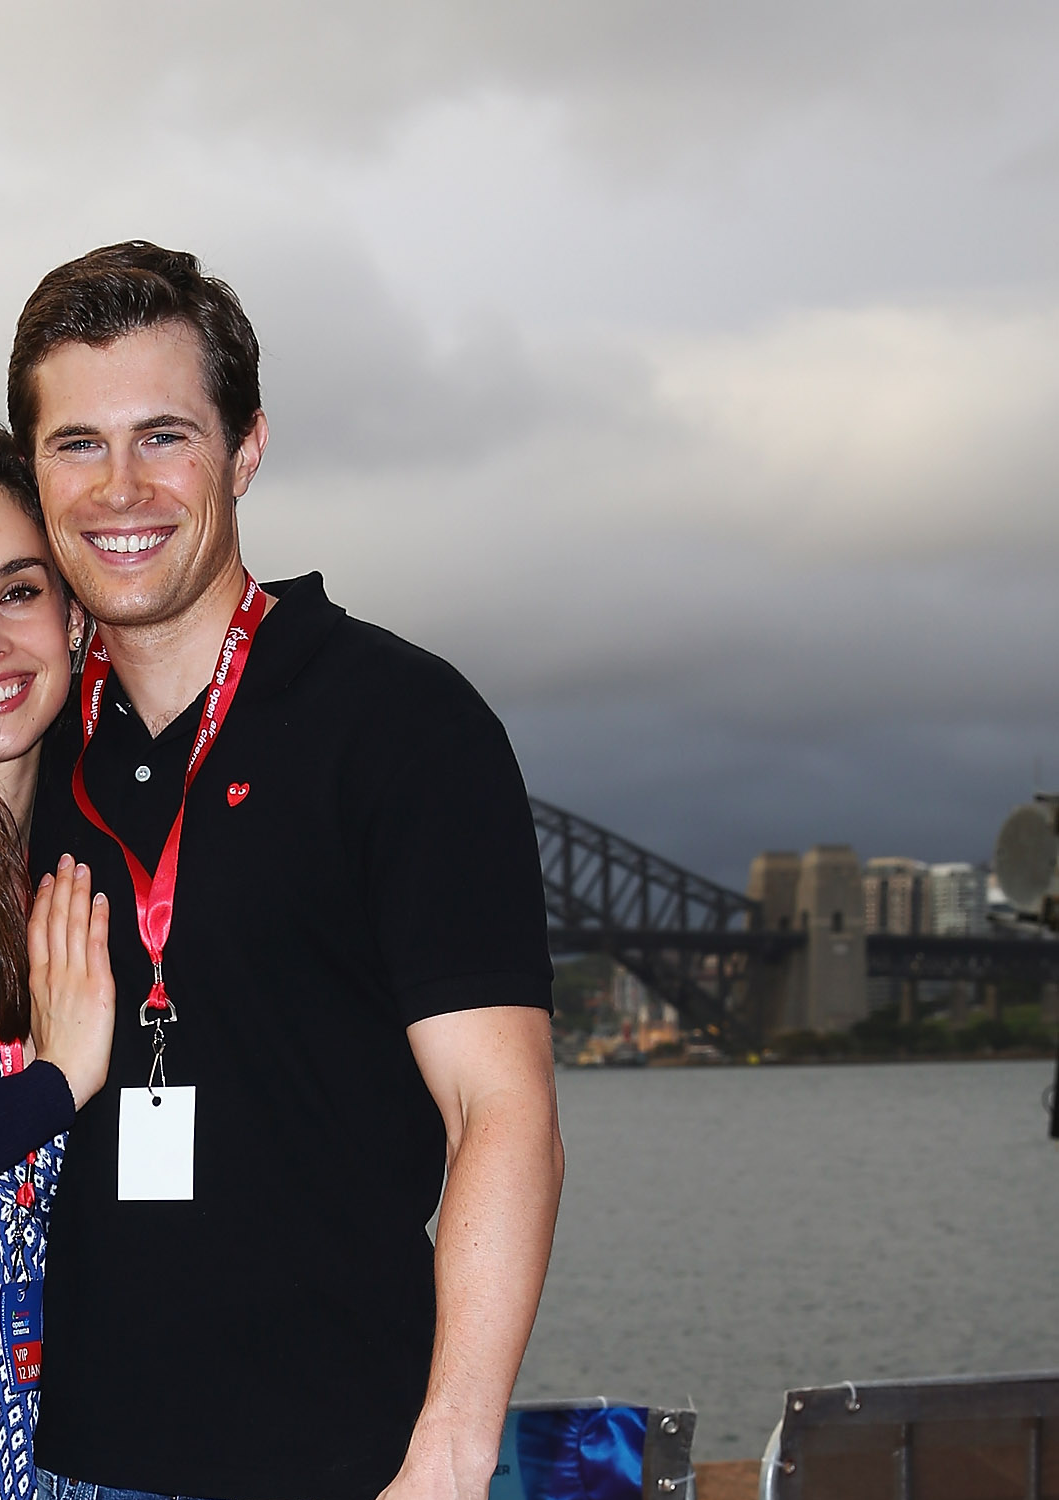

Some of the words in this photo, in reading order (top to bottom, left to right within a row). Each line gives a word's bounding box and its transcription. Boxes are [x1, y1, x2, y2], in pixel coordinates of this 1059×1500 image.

[241, 581, 258, 612] cinema
[216, 638, 237, 685] st.george
[90, 679, 104, 720] cinema
[206, 688, 221, 718] open
[209, 720, 217, 739] air
[15, 1347, 28, 1362] VIP
[17, 1366, 27, 1380] 12
[27, 1364, 40, 1379] JAN
